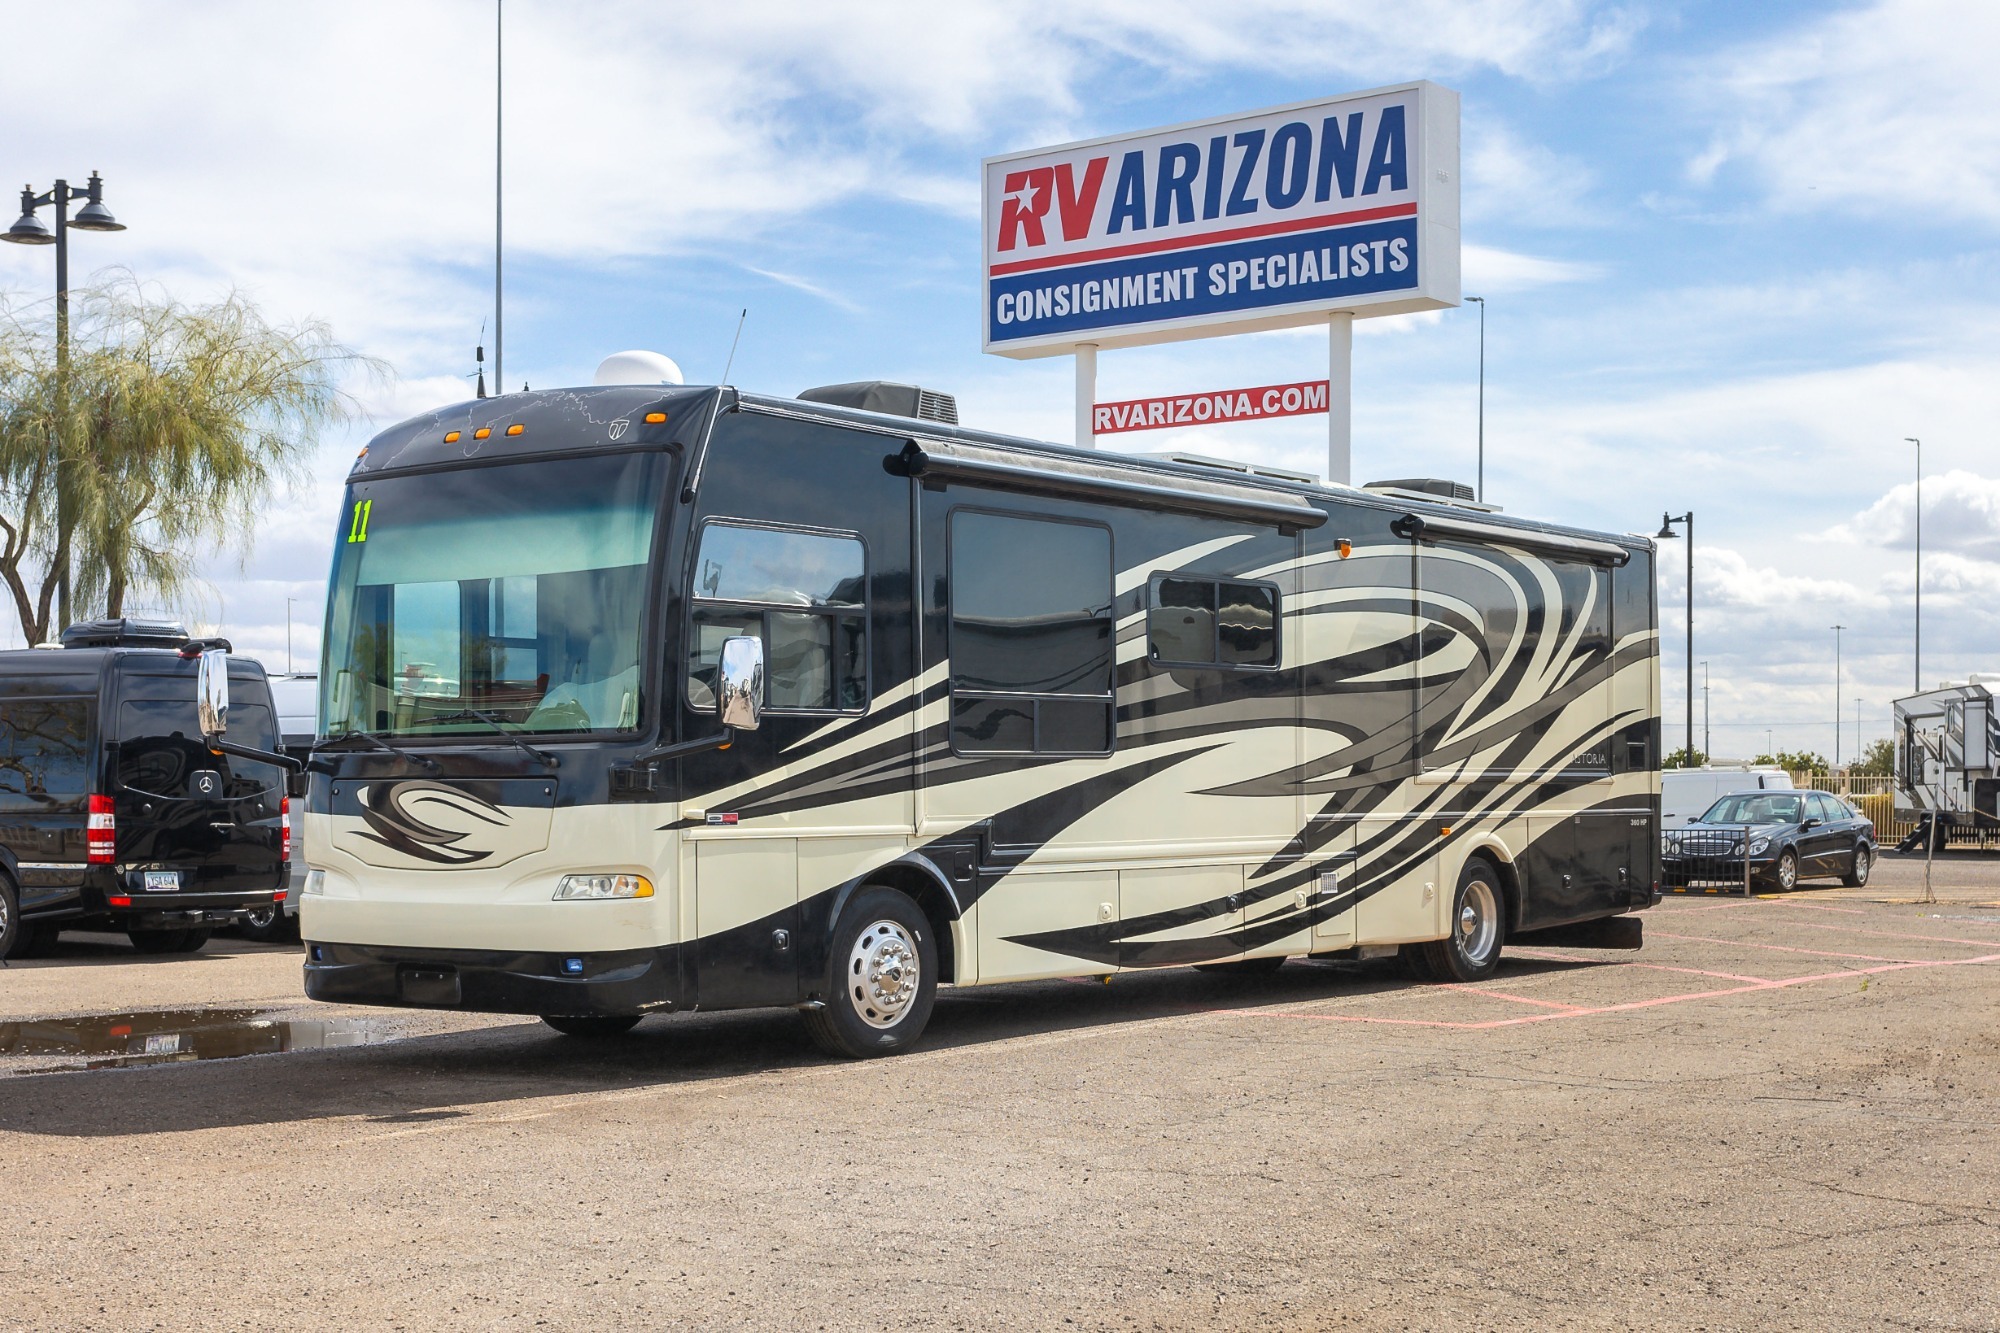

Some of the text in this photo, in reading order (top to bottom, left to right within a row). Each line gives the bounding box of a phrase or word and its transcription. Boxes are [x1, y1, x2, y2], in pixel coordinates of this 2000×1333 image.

[997, 237, 1409, 324] CONSIGNMENT SPECIALISTS
[1094, 384, 1327, 431] RVARIZONA.COM
[347, 499, 372, 543] 11
